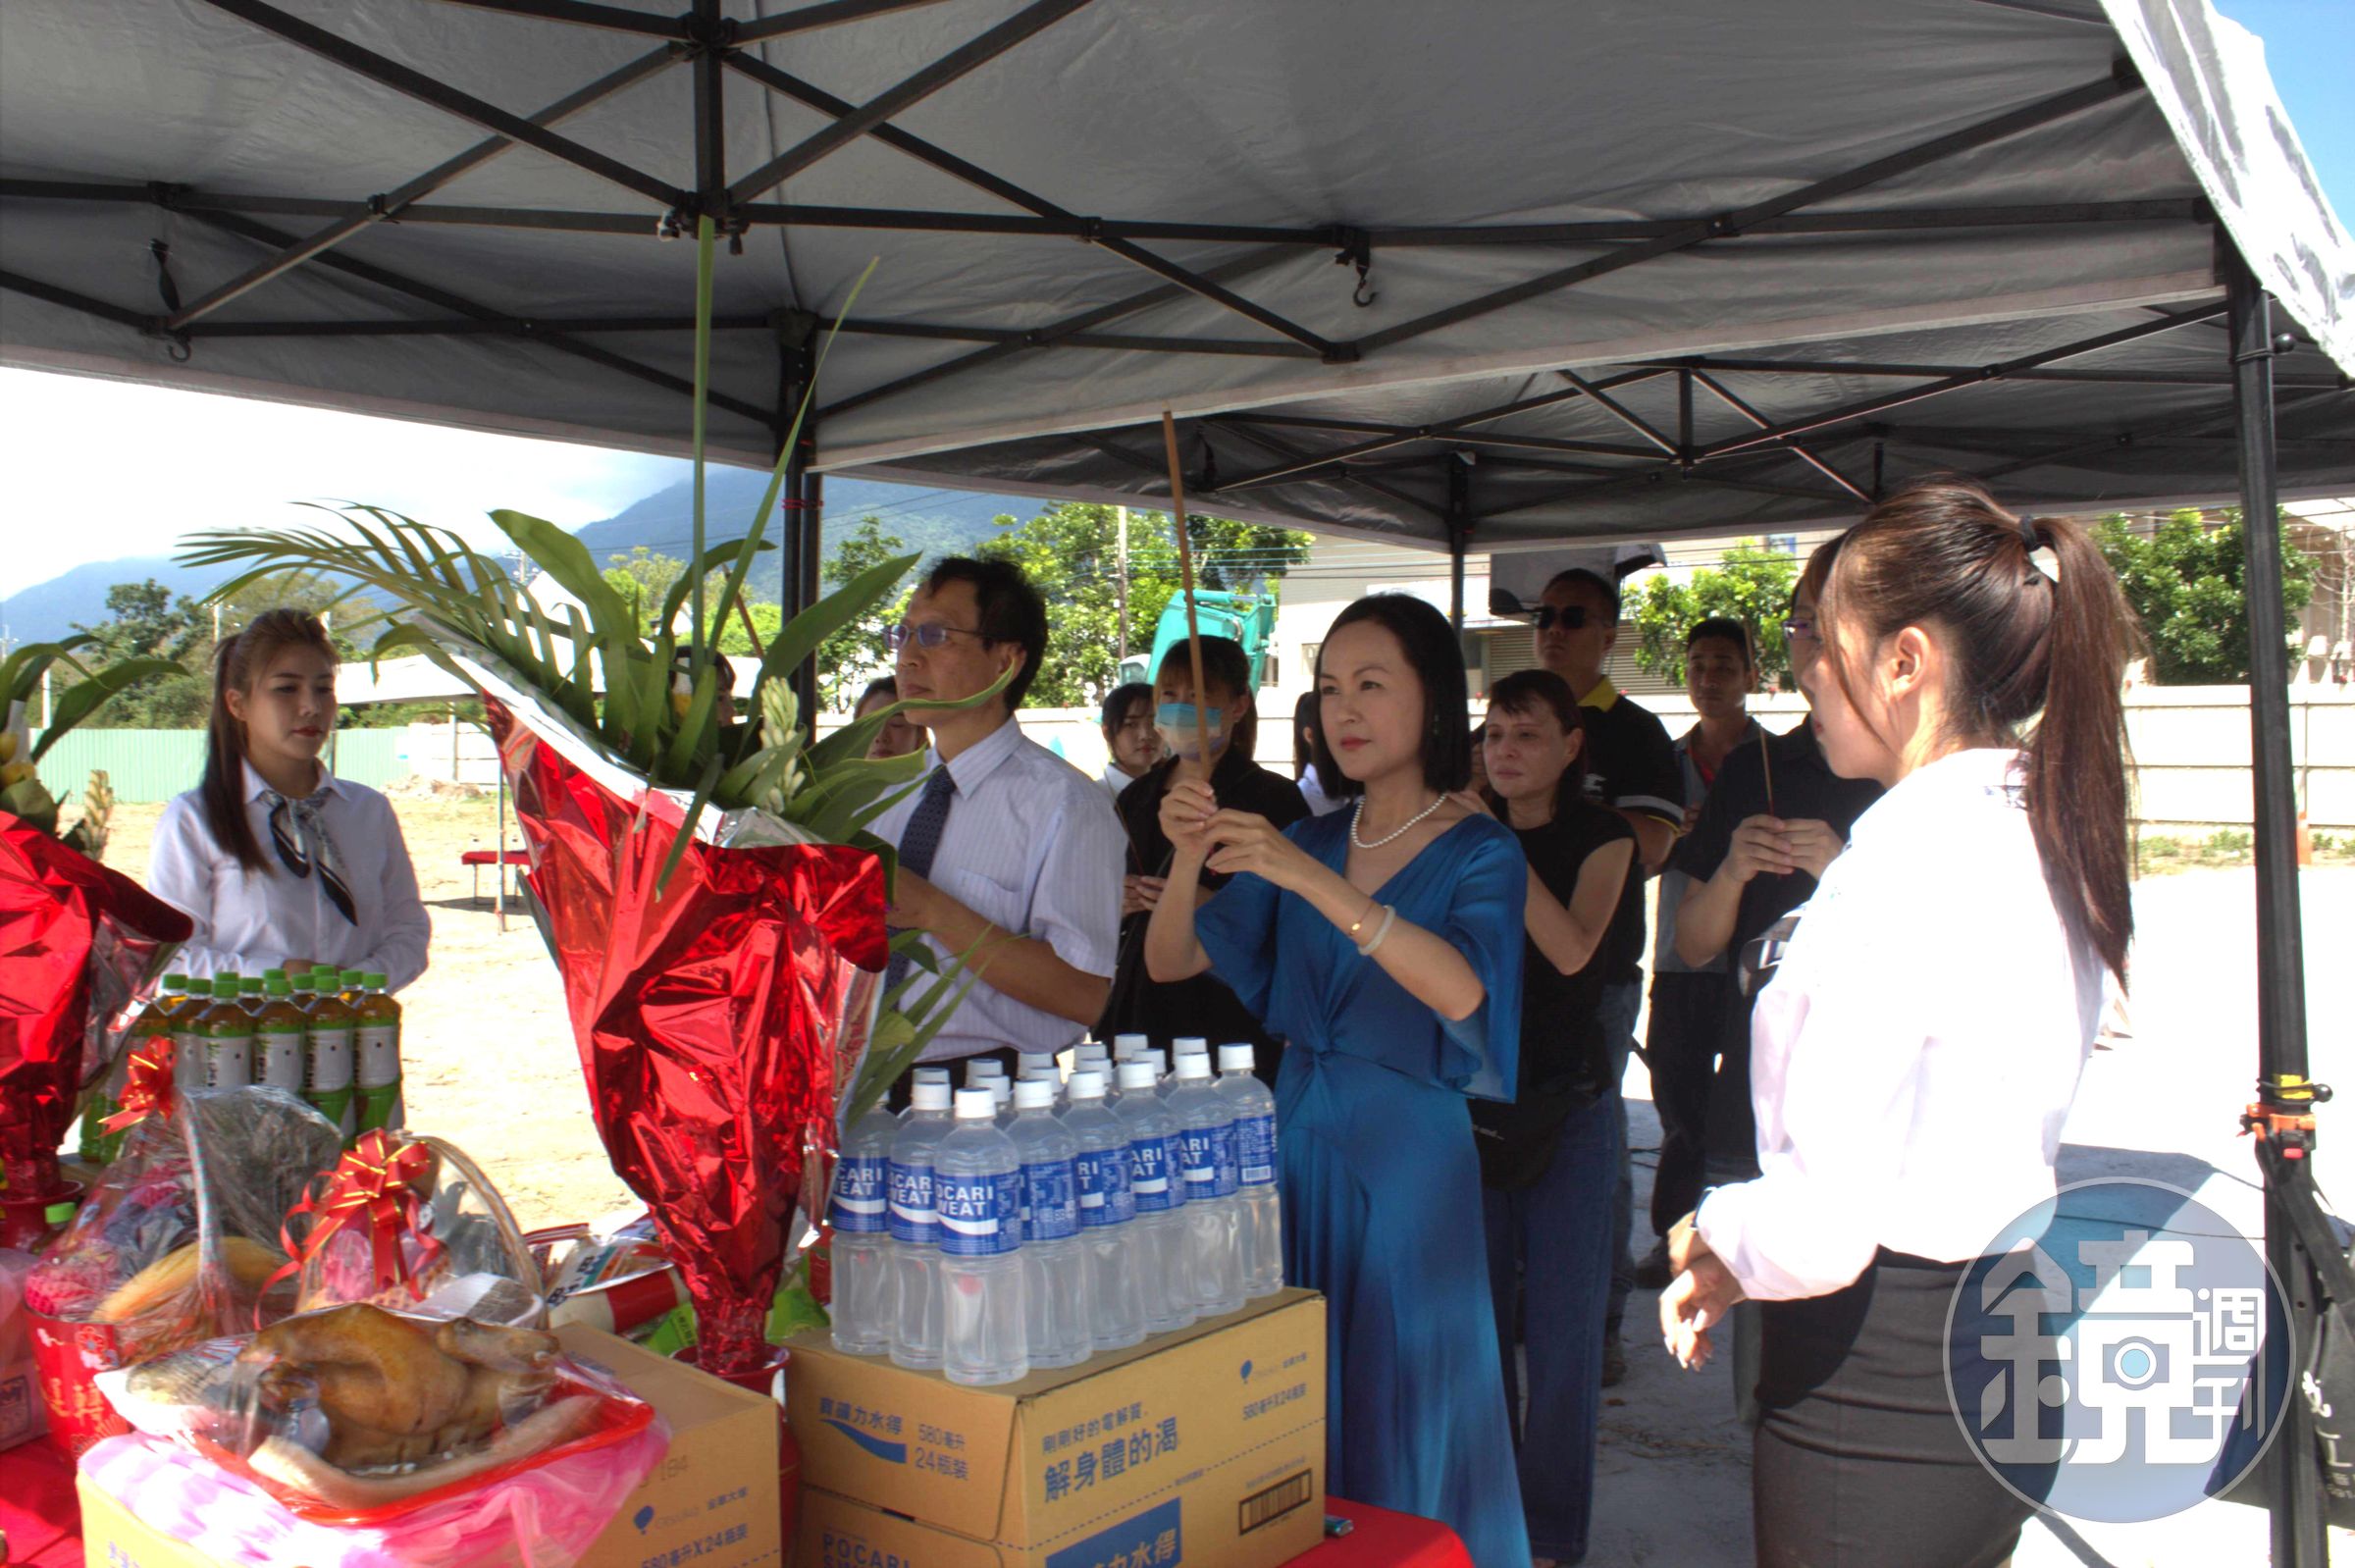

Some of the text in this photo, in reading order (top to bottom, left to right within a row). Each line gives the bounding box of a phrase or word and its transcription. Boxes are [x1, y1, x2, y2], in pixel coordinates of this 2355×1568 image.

[1179, 1137, 1210, 1154] ARI
[1130, 1147, 1163, 1167] ARI
[836, 1166, 882, 1182] CARI
[890, 1172, 932, 1190] CAR
[837, 1181, 875, 1196] EAT
[890, 1189, 933, 1205] EAT
[936, 1184, 994, 1201] OCARI
[937, 1201, 987, 1217] WEAT
[1093, 1528, 1178, 1568] 力水得
